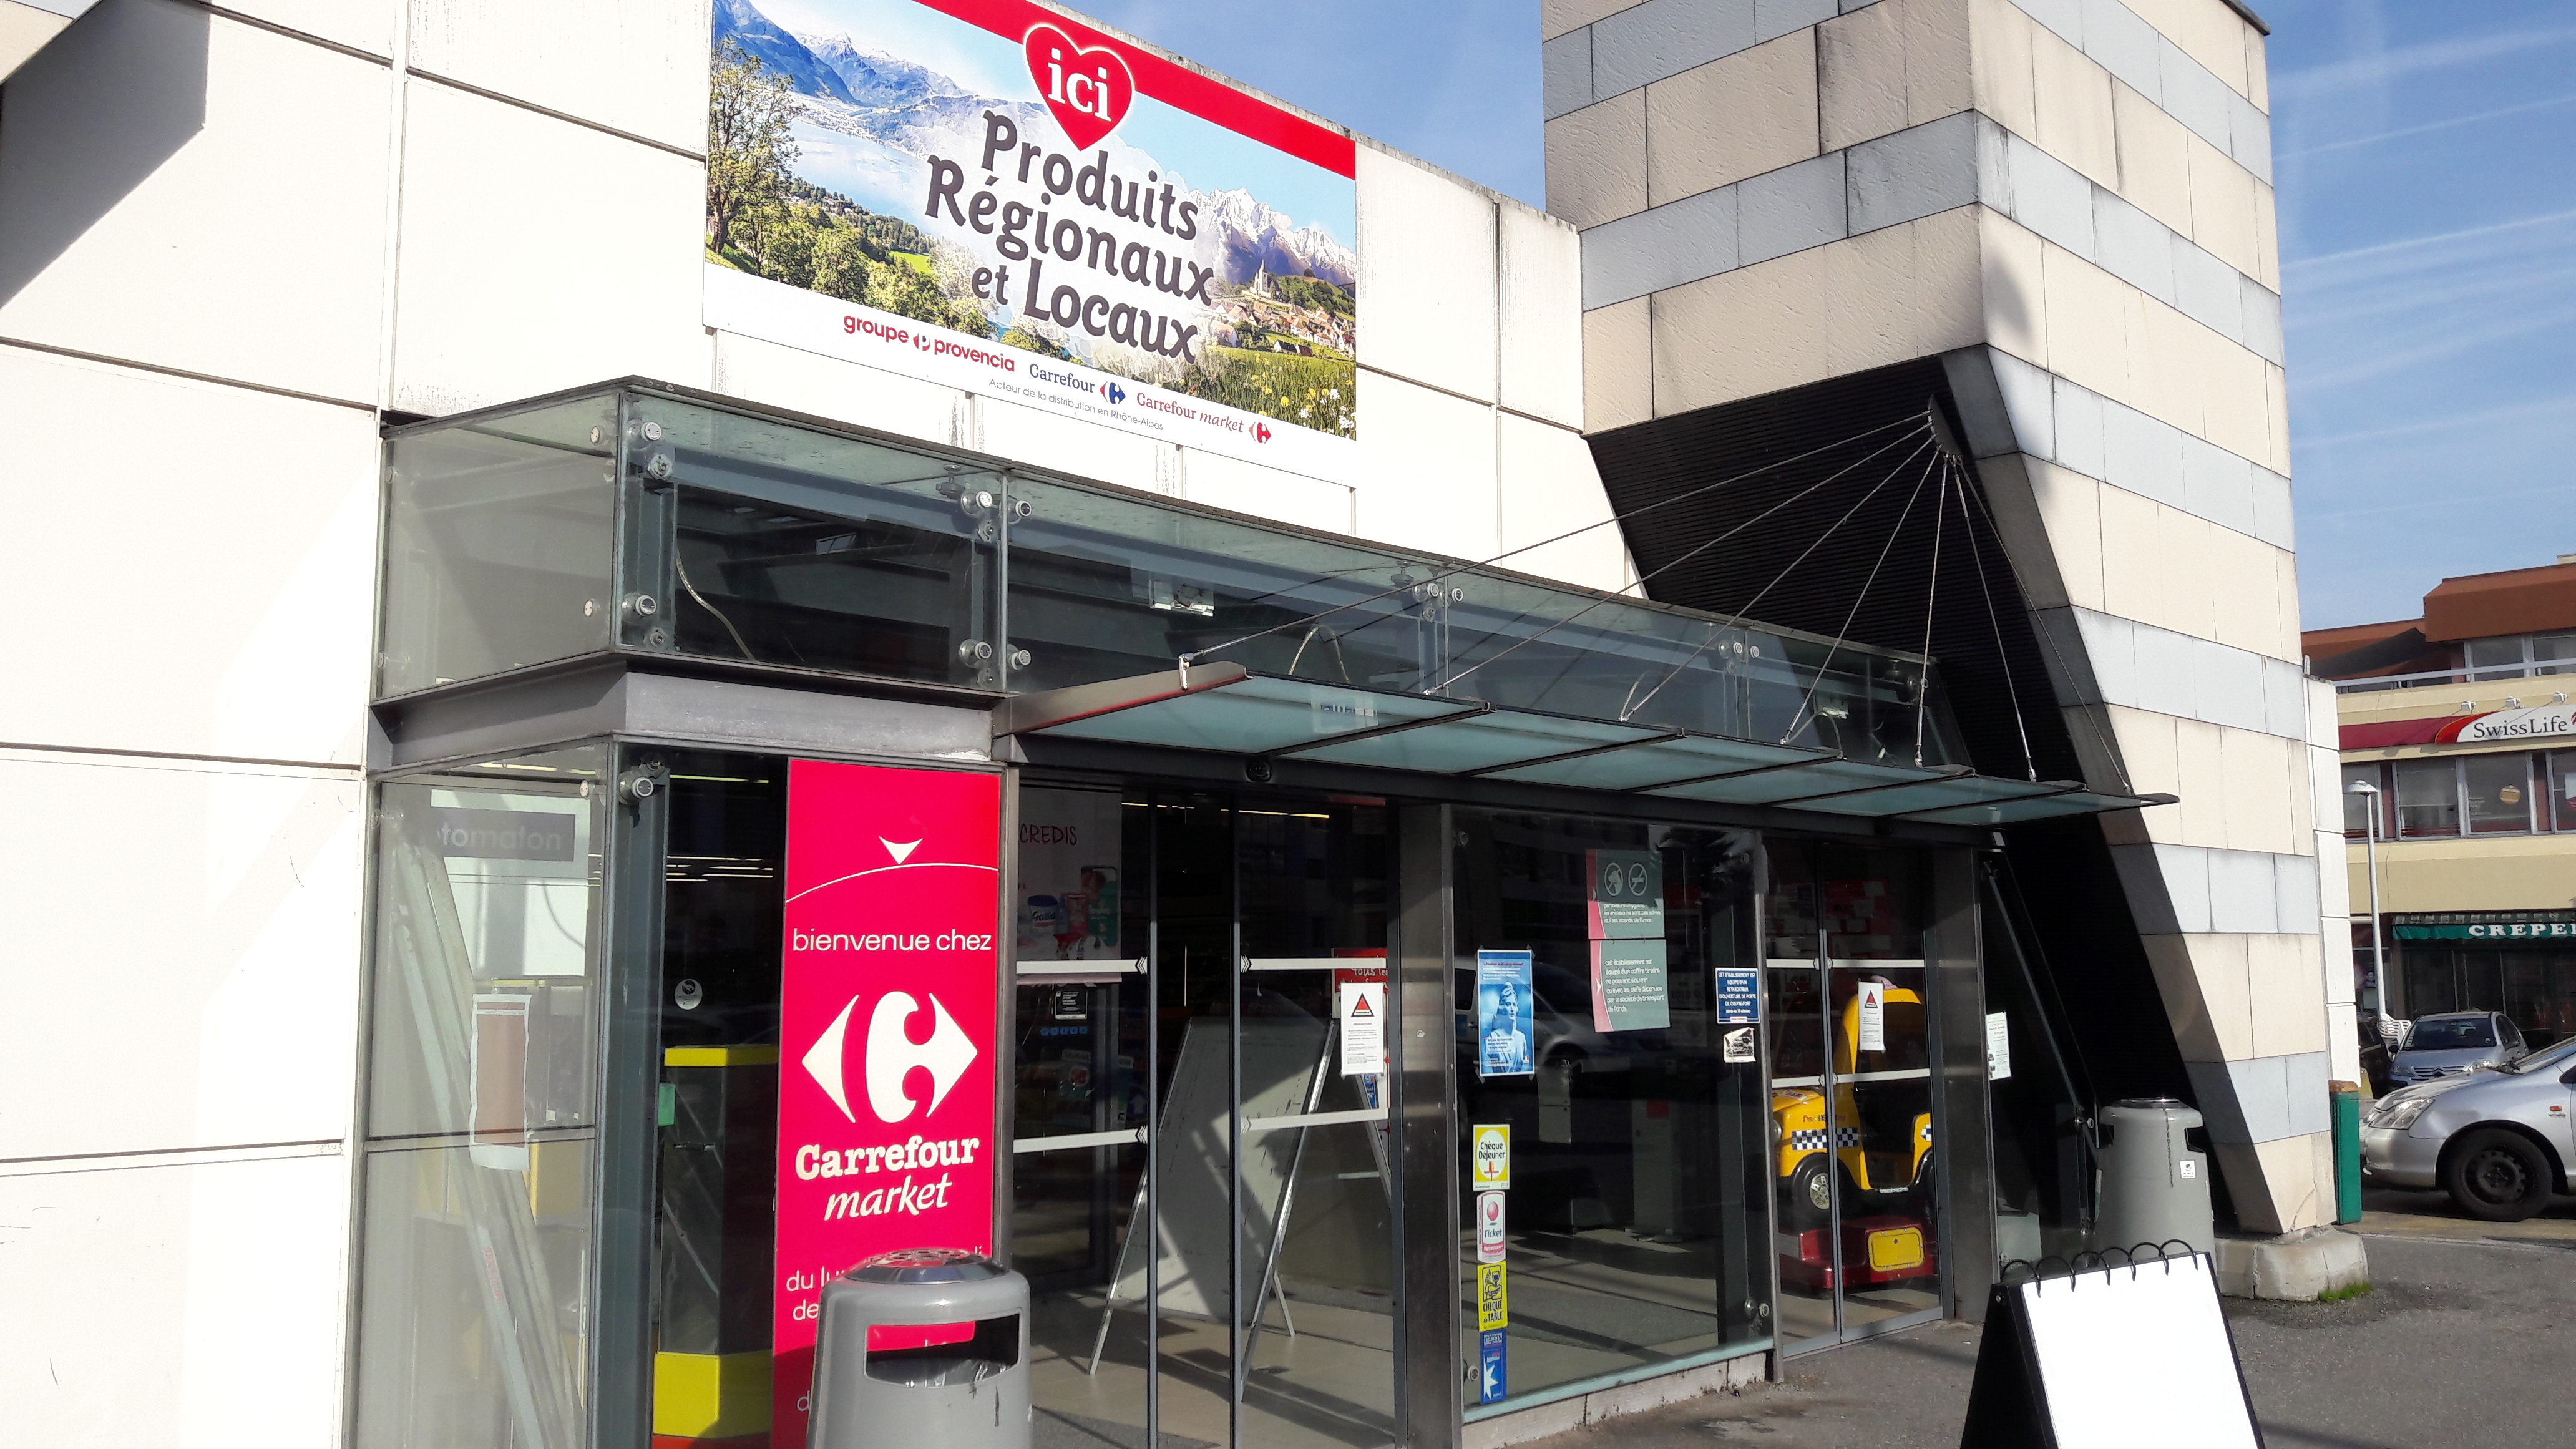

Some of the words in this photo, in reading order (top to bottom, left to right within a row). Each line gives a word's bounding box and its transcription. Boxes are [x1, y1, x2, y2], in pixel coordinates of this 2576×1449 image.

[1047, 47, 1112, 122] ici
[981, 110, 1198, 241] Produits
[925, 154, 1214, 306] Régionaux
[972, 264, 1009, 305] et
[1023, 256, 1198, 364] Locaux
[843, 315, 909, 343] groupe
[934, 338, 1015, 372] provencia
[1029, 363, 1095, 393] Carrefour
[989, 378, 1021, 394] Acteur
[1023, 388, 1036, 398] de
[1038, 391, 1046, 400] la
[1048, 393, 1096, 413] distribution
[1098, 407, 1109, 417] en
[1111, 410, 1163, 430] Rhône-Alpes
[1136, 393, 1197, 420] Carrefour
[1199, 413, 1245, 432] market
[2474, 715, 2568, 738] SwissLife
[437, 822, 560, 849] tomaton
[793, 928, 930, 951] bienvenue
[936, 928, 992, 951] chez
[794, 1134, 980, 1181] Carrefour
[1480, 1140, 1503, 1151] Chèque
[824, 1174, 953, 1221] market
[1485, 1228, 1502, 1238] Ticket
[786, 1270, 814, 1292] du
